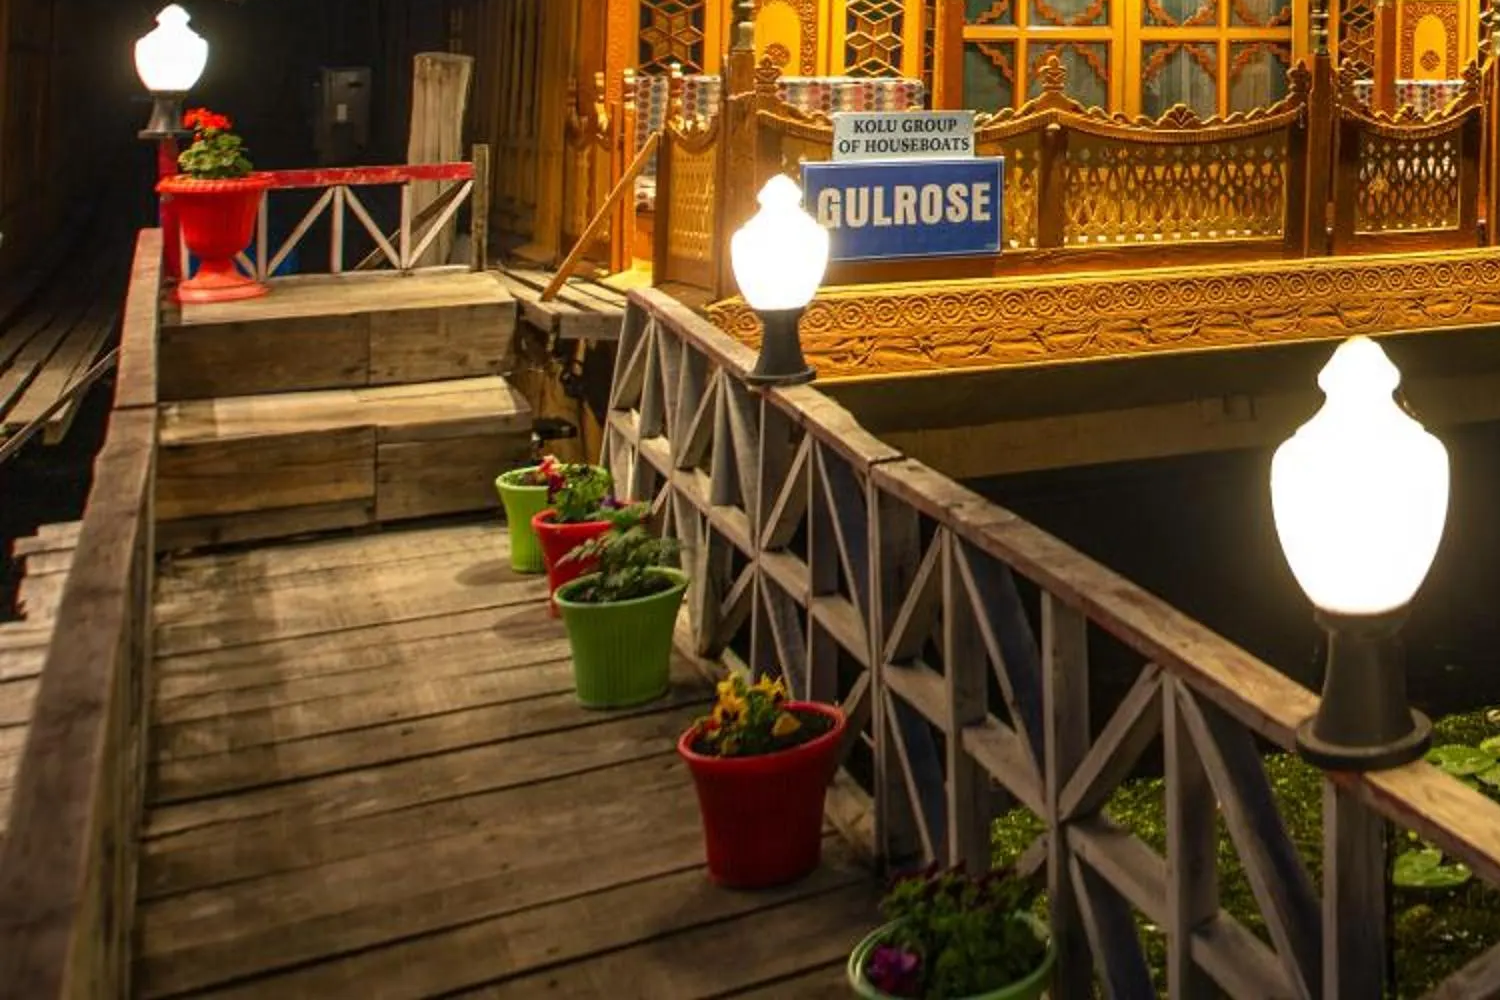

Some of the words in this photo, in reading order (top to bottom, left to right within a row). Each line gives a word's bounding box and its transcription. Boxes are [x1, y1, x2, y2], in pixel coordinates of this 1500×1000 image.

[853, 119, 896, 134] KOLU
[902, 119, 957, 133] GROUP
[838, 139, 860, 154] OF
[865, 137, 970, 153] HOUSEBOATS
[817, 183, 991, 229] GULROSE
